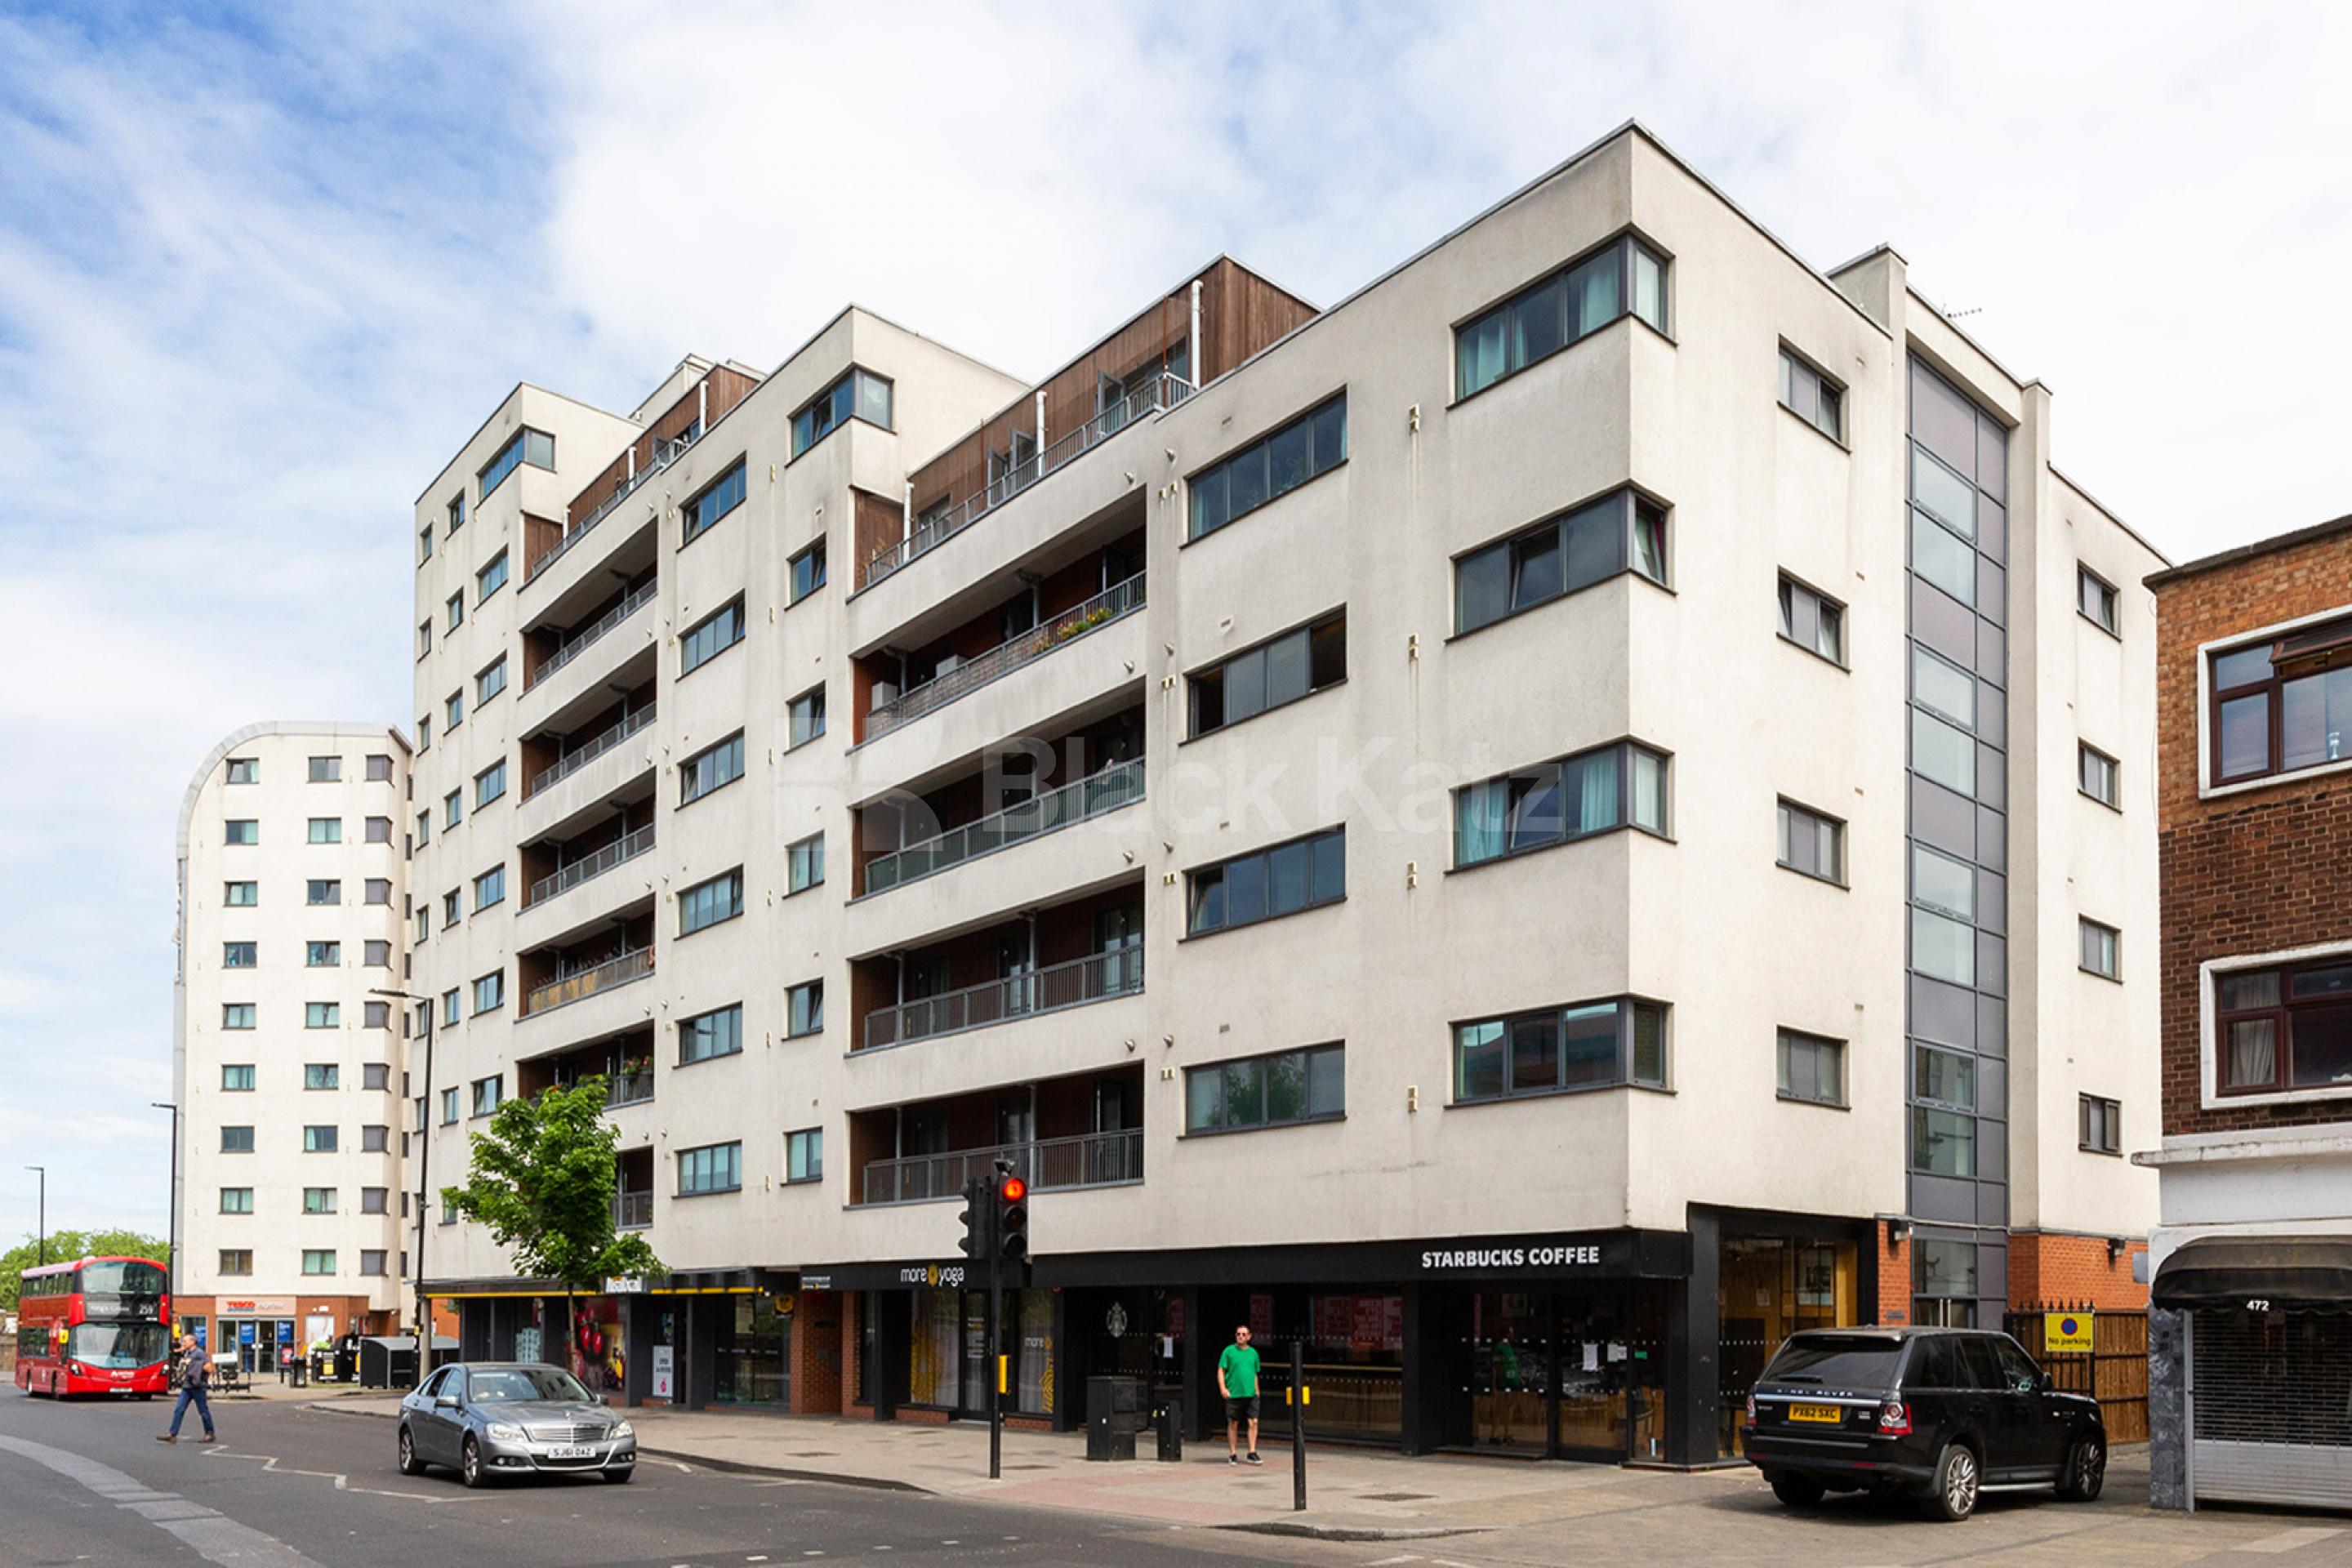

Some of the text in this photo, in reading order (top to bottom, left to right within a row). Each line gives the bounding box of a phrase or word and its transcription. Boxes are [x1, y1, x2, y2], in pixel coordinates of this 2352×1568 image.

[1422, 1246, 1600, 1268] STARBUCKS COFFEE
[900, 1267, 964, 1287] more yoga
[226, 1300, 256, 1308] TESCO
[2246, 1300, 2270, 1312] 472
[1024, 1337, 1045, 1348] more
[2047, 1337, 2091, 1348] No parking
[1793, 1406, 1837, 1419] PX62 SXC
